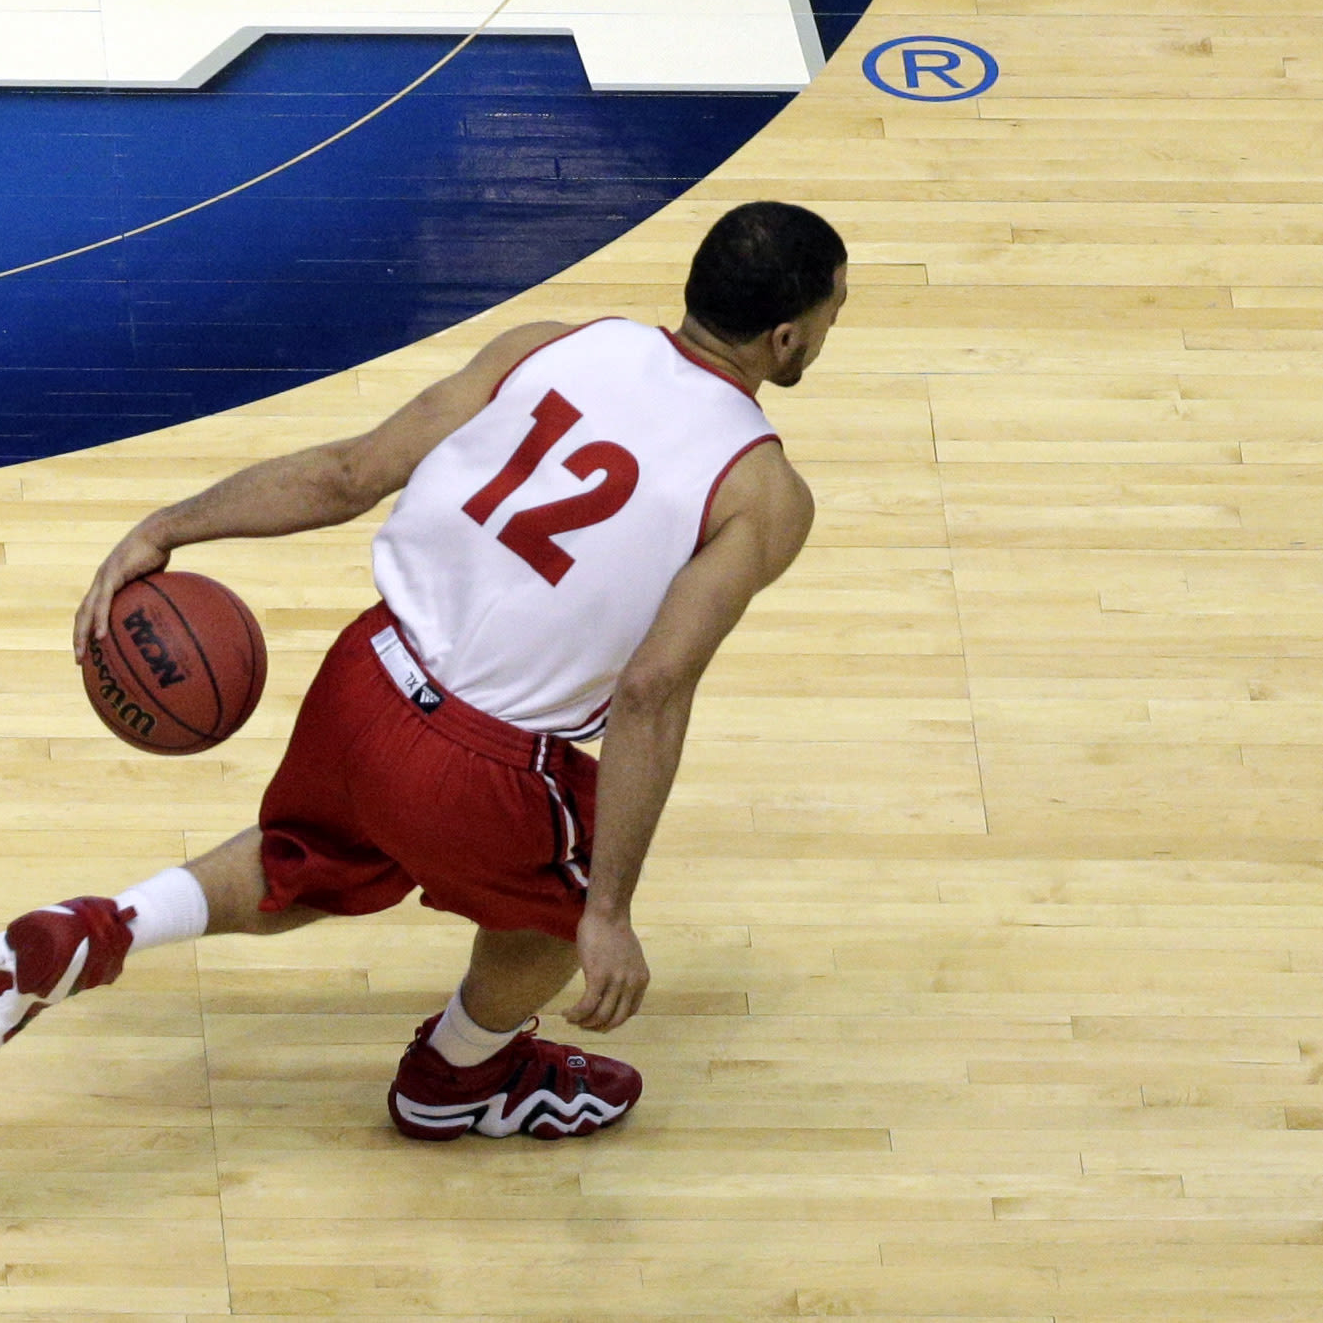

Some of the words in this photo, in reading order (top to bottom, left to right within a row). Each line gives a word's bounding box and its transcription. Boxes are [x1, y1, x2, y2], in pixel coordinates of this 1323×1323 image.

[462, 388, 640, 587] 12
[123, 608, 186, 688] NCAA
[404, 671, 420, 691] XL
